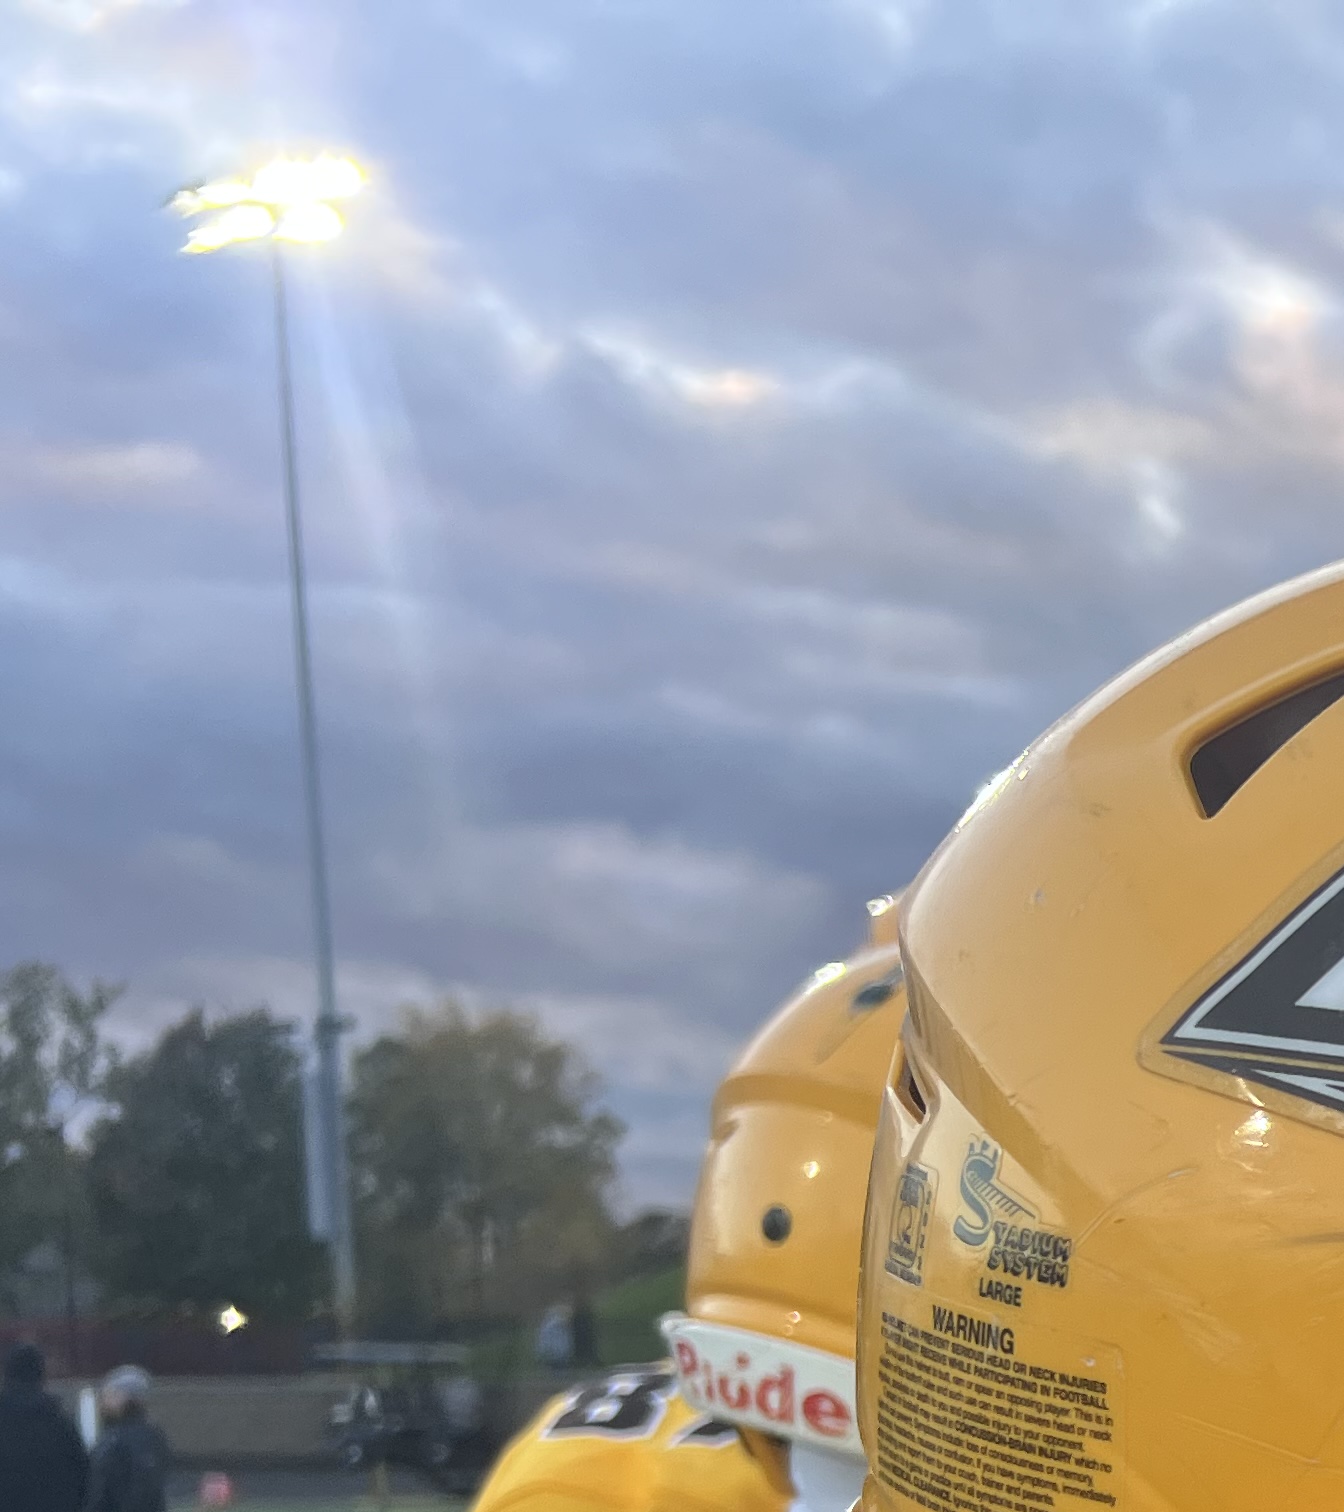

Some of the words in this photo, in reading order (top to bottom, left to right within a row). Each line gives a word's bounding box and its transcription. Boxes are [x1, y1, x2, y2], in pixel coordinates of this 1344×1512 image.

[987, 1246, 1070, 1288] SYSTEM
[979, 1278, 1022, 1307] LARGE
[932, 1304, 1014, 1355] WARNING
[951, 1341, 985, 1362] SERIOUS
